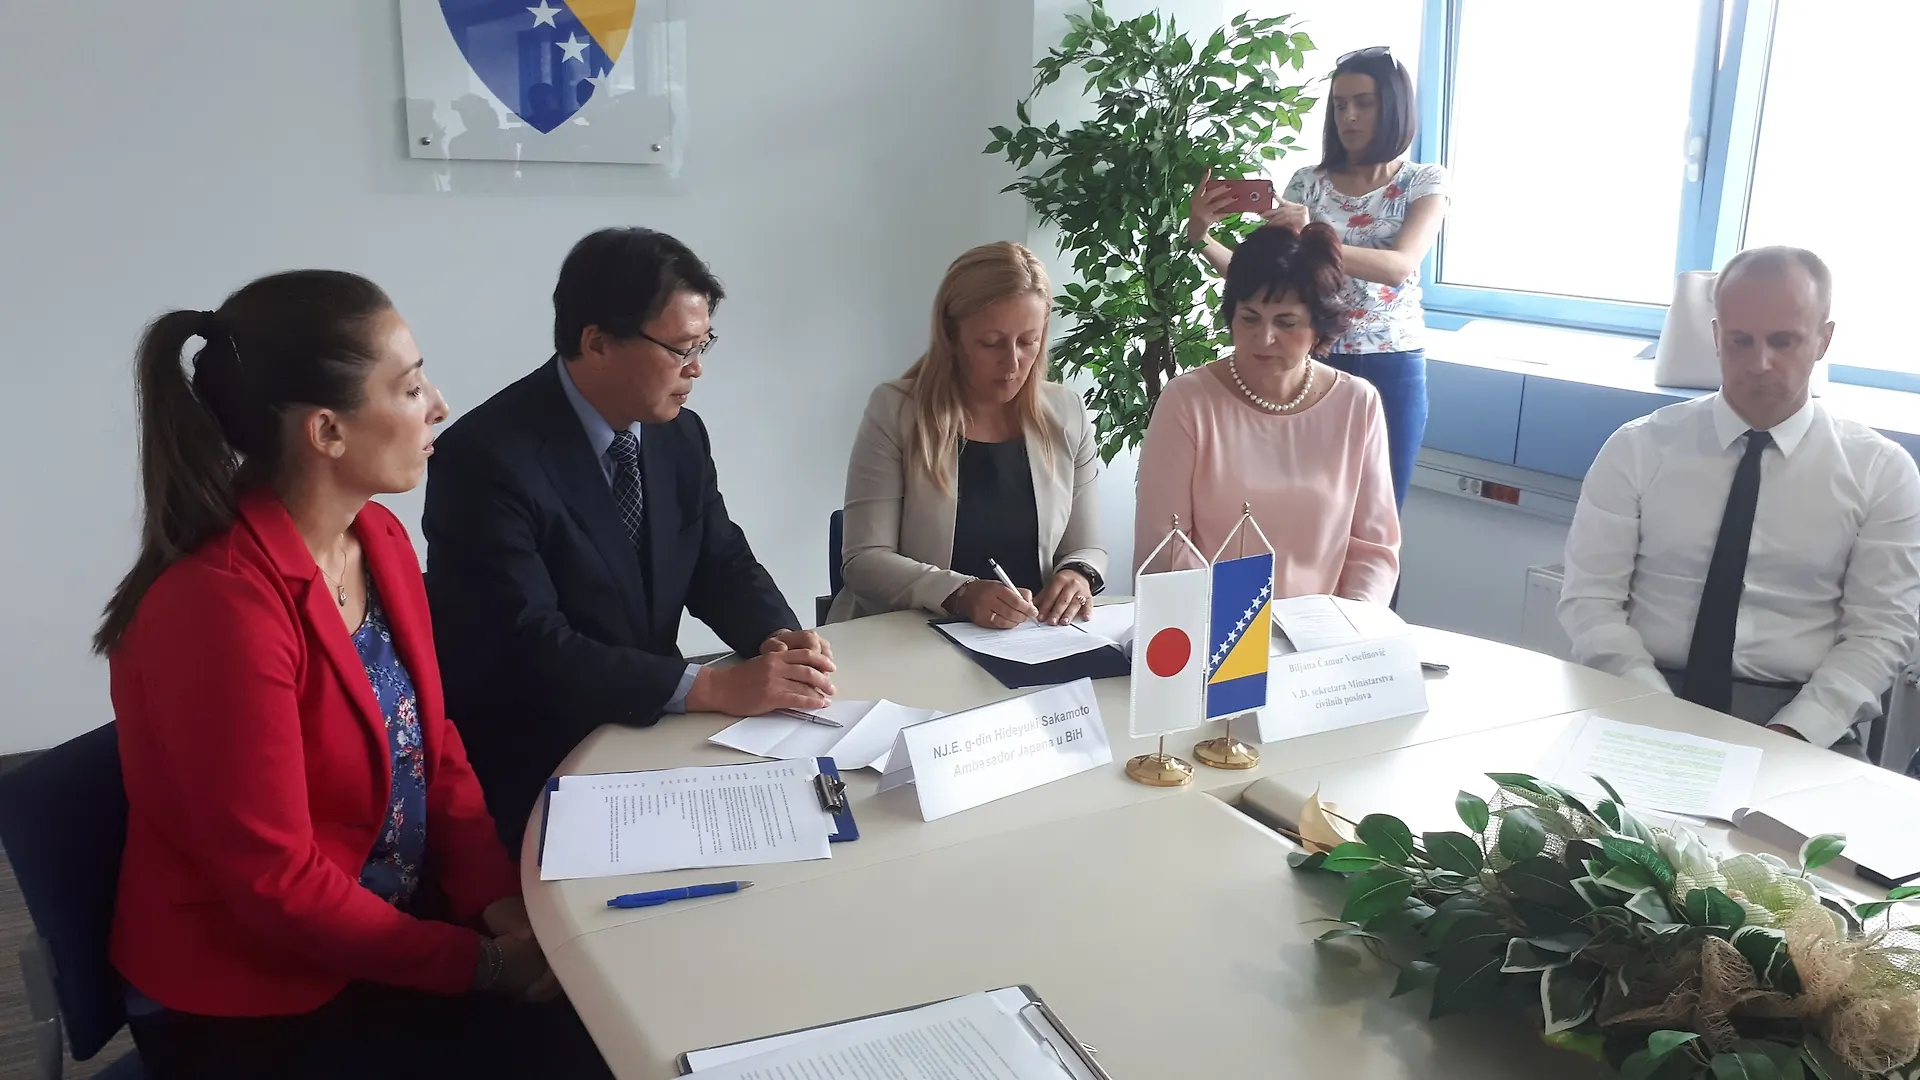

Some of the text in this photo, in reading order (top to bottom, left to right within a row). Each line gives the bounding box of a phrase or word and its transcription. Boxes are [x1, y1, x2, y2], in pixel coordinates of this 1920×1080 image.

[1288, 661, 1316, 673] Biljana
[1311, 682, 1347, 697] sekretara
[1347, 674, 1394, 690] Ministarstva
[1315, 691, 1372, 709] civilnih poslova
[933, 705, 1090, 759] NJ.E. g-din Hideyuki Sakamoto
[953, 728, 1083, 778] Ambasador Japana u BiH
